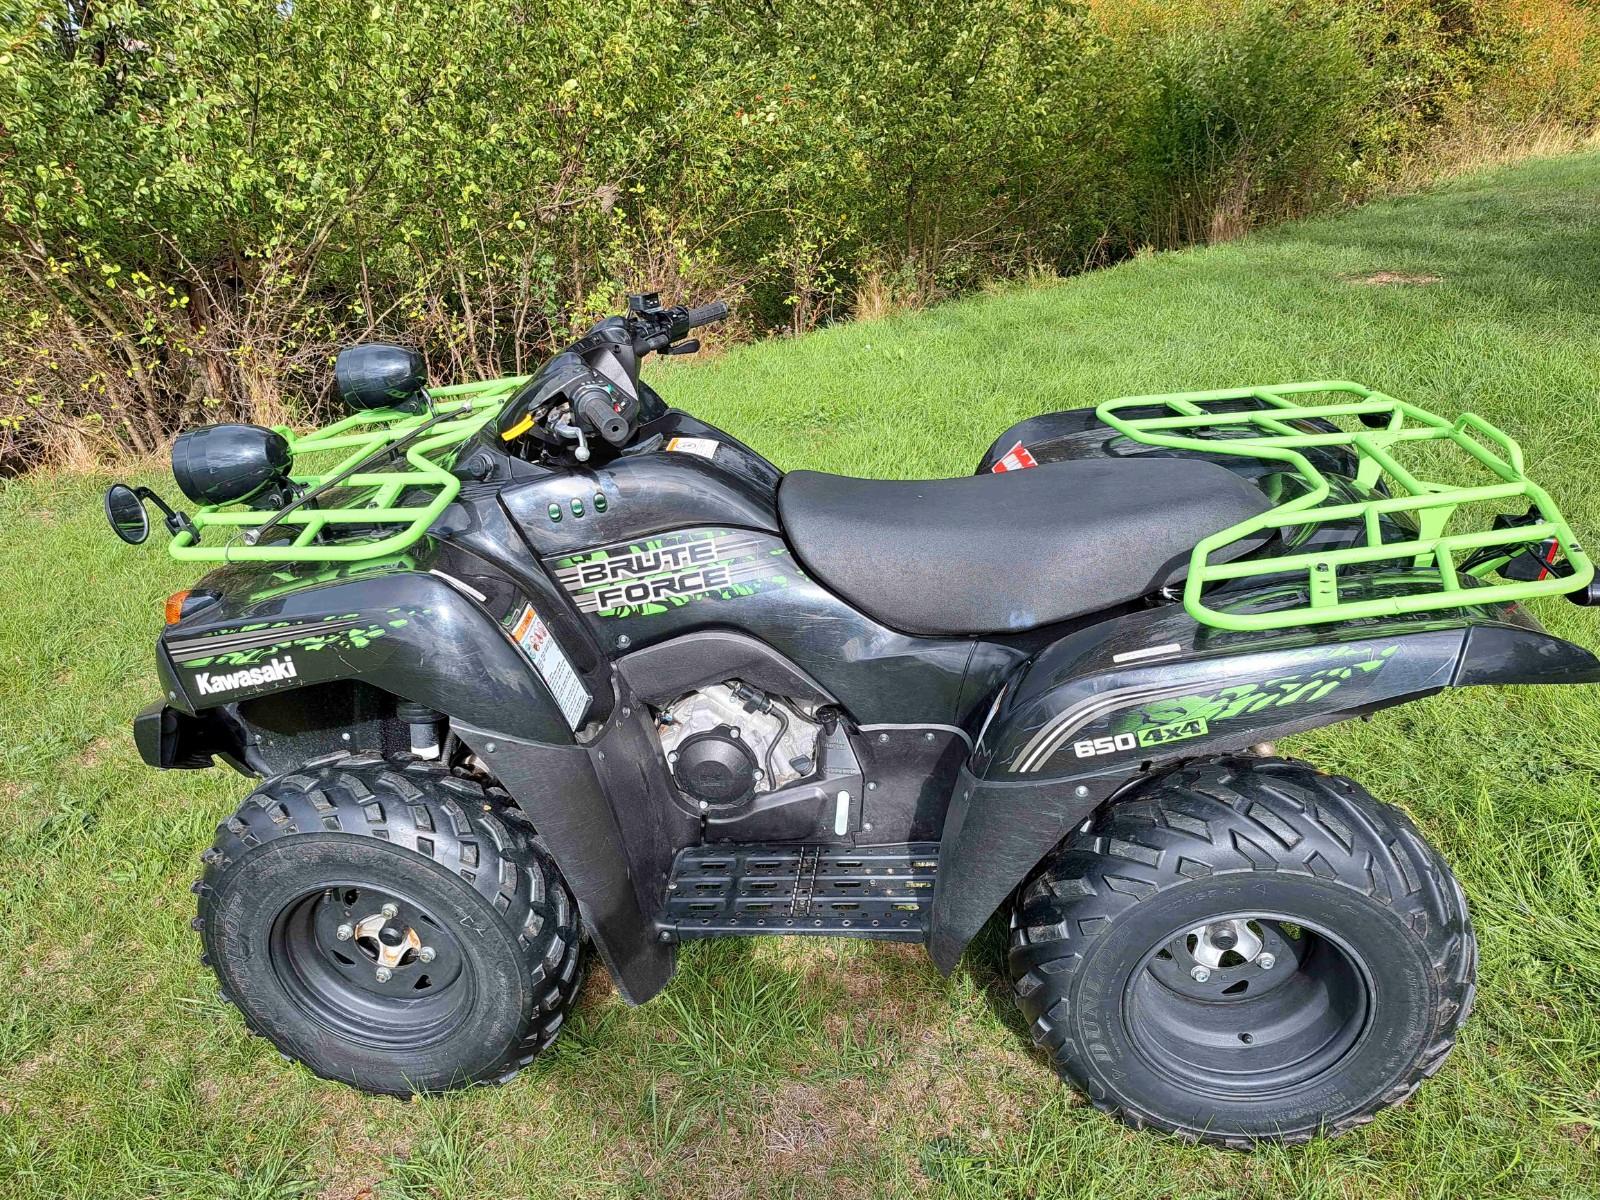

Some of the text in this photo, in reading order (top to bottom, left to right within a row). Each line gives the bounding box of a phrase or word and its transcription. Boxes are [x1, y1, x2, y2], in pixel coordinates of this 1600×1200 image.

[578, 540, 716, 586] BRUTE
[596, 567, 730, 609] FORCE
[195, 656, 297, 695] Kawasaki
[1073, 719, 1202, 758] 650 4x4
